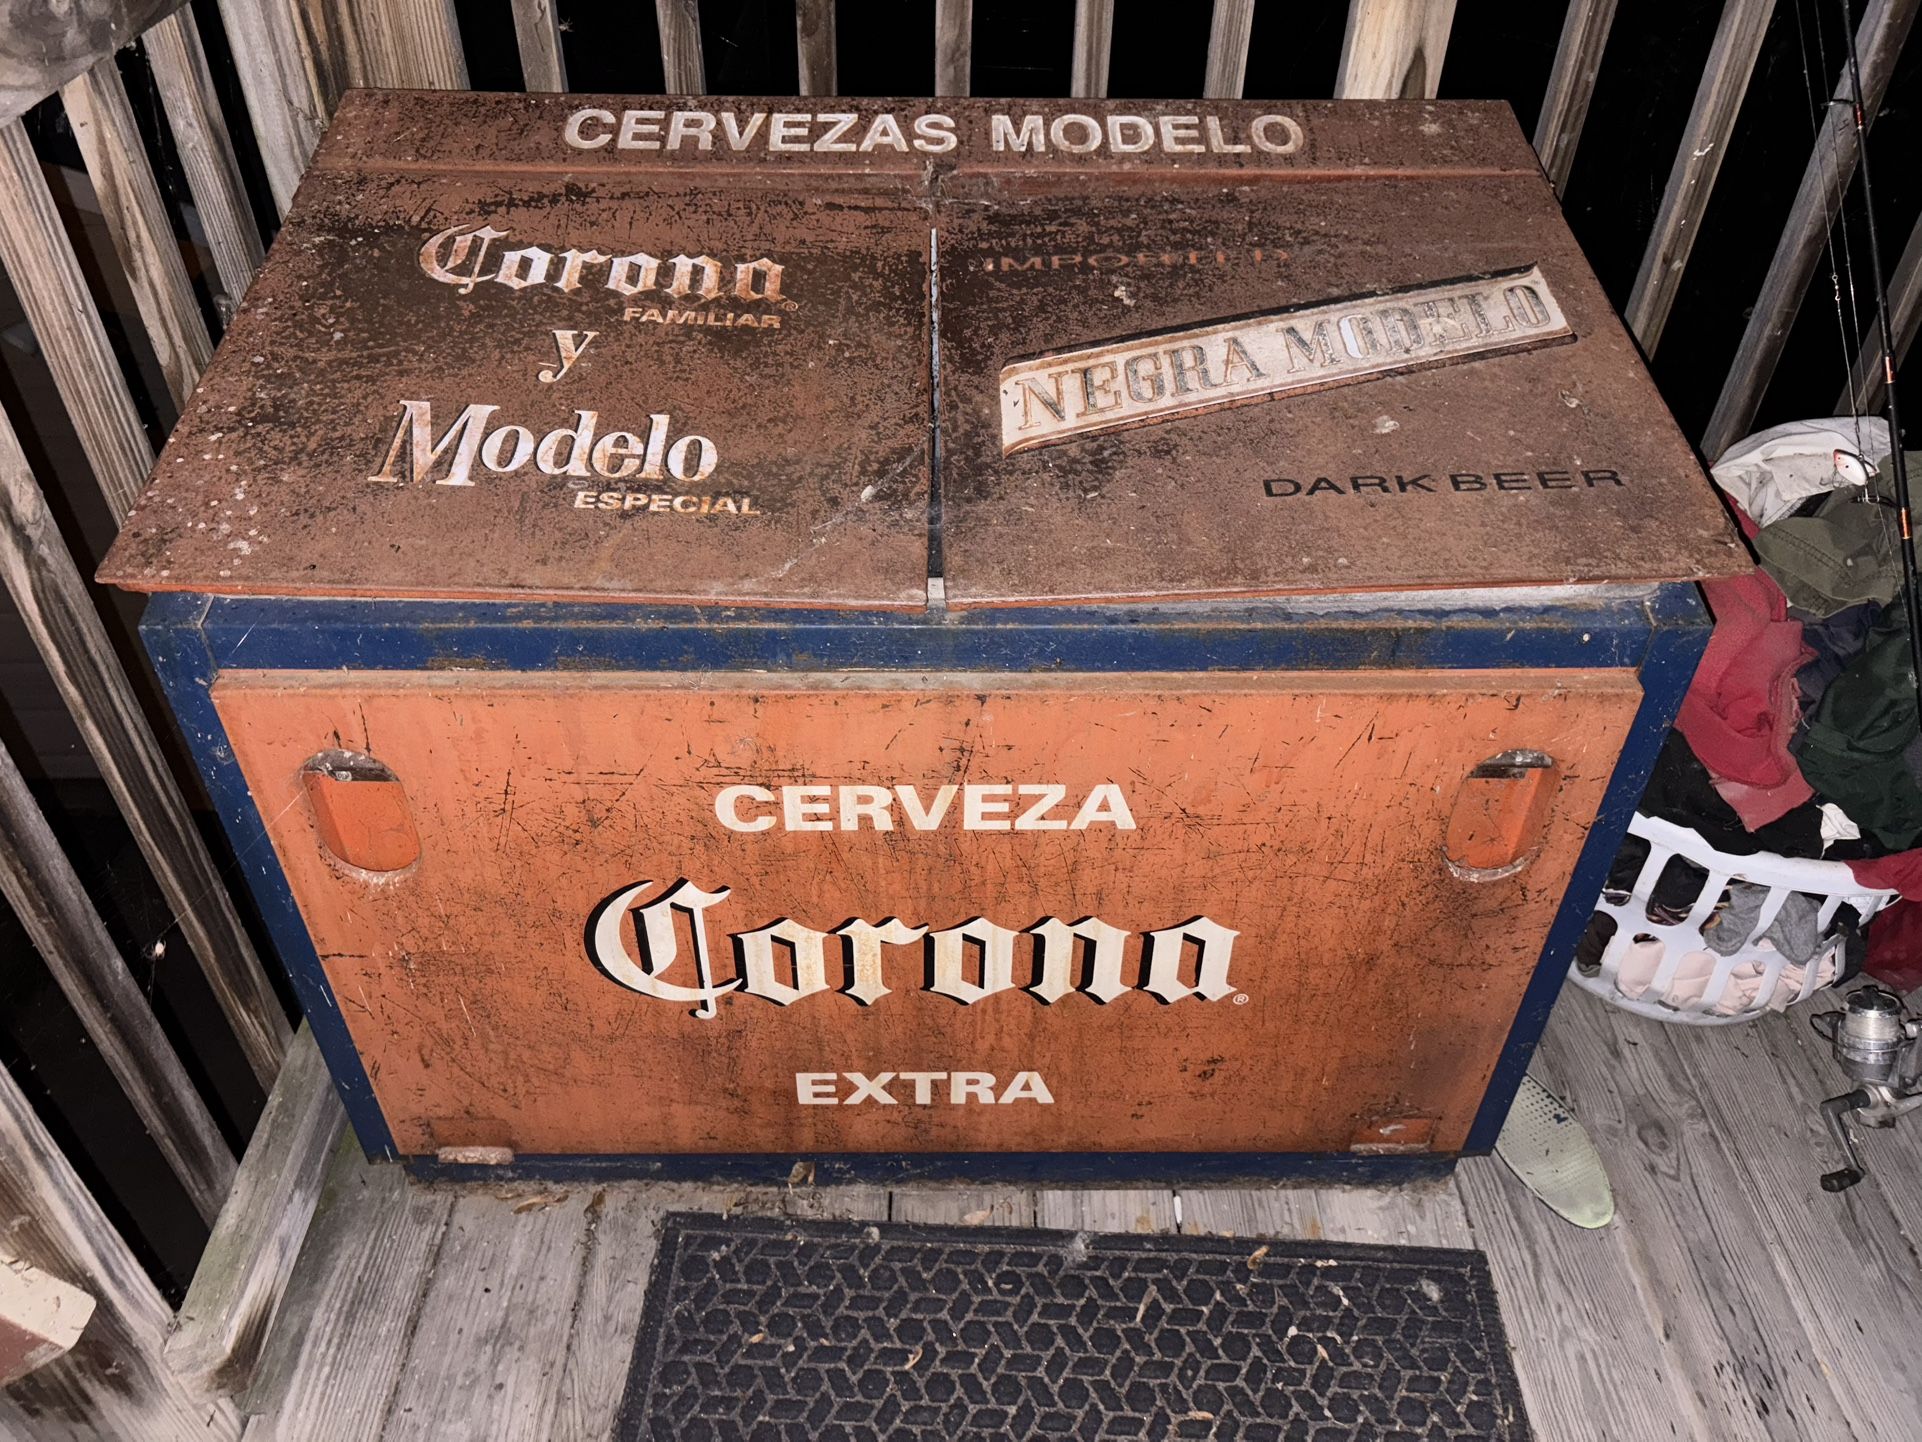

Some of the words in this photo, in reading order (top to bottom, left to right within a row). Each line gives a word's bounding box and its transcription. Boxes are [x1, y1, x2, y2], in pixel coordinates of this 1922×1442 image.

[563, 107, 959, 154] CERVEZAS
[990, 113, 1305, 154] MODELO
[622, 307, 782, 330] FAMILIAR
[537, 329, 600, 384] y
[1013, 335, 1268, 432] NEGRA
[1275, 284, 1552, 375] MODELO
[367, 399, 720, 487] Modelo
[573, 491, 762, 516] ESPECIAL
[1262, 474, 1436, 498] DARK
[1449, 469, 1626, 493] BEER
[714, 784, 1138, 832] CERVEZA
[795, 1071, 1055, 1105] EXTRA
